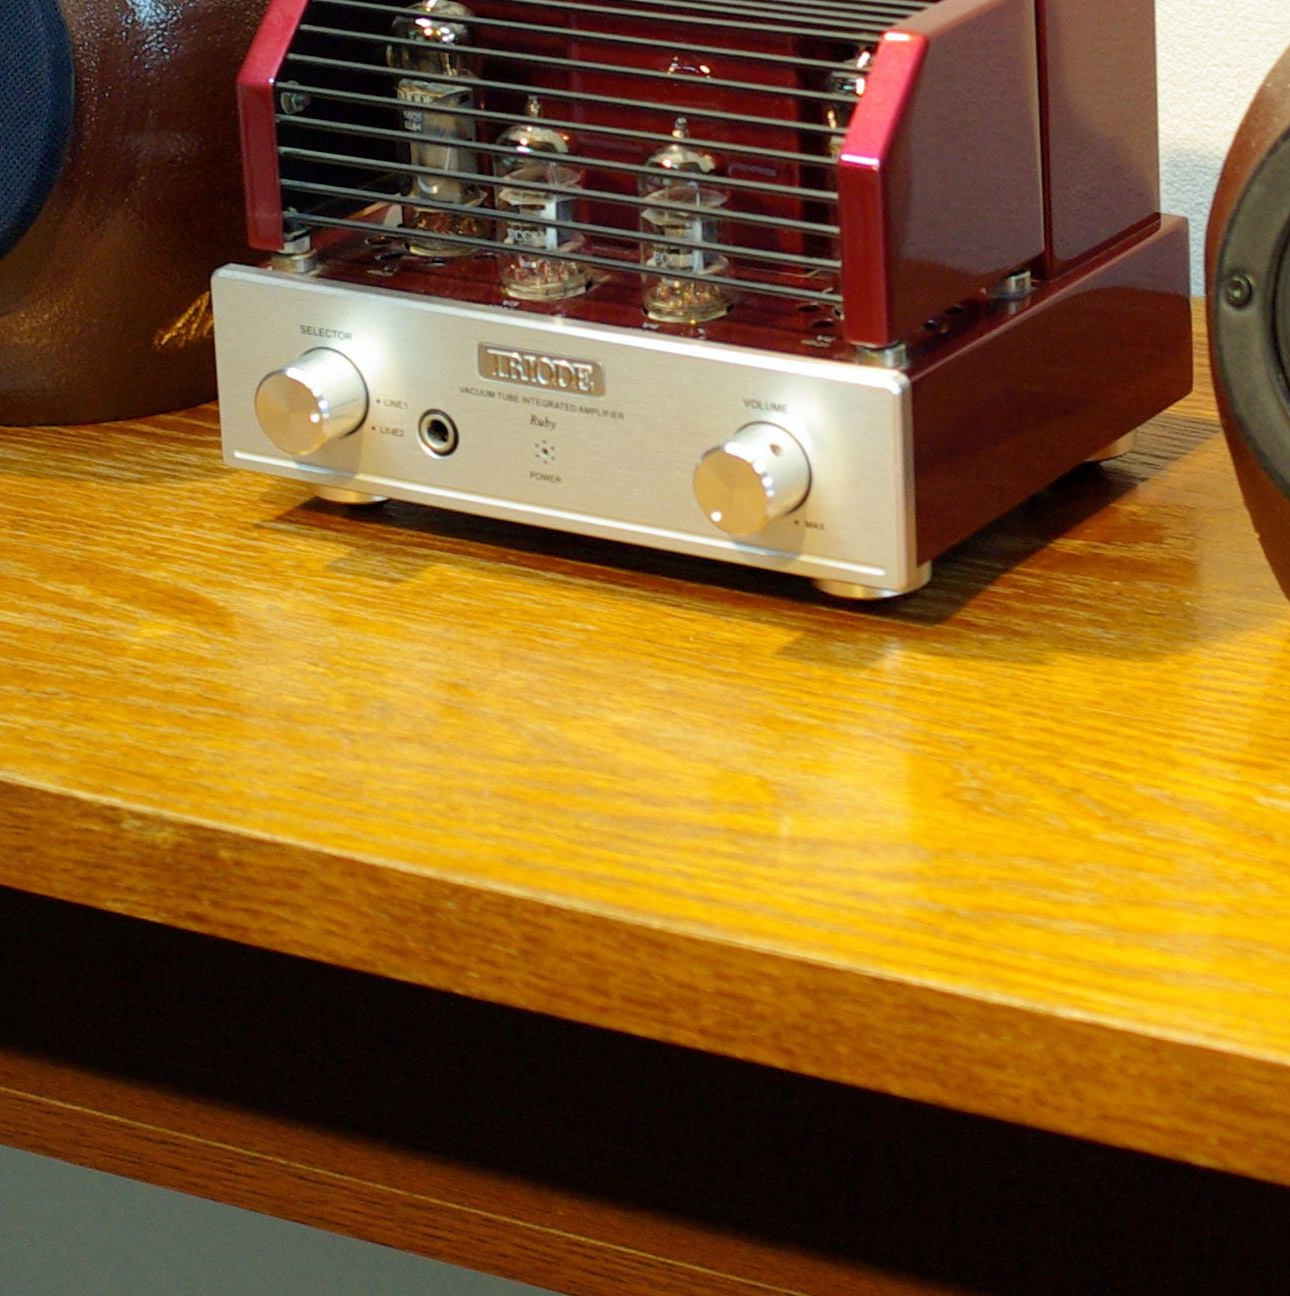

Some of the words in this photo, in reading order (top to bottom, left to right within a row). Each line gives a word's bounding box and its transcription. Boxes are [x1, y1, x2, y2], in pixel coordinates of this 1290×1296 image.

[299, 325, 352, 341] SELECTOR
[485, 348, 596, 392] TRIODE
[383, 399, 409, 410] LINE1
[459, 386, 496, 400] VACUUM
[497, 392, 520, 404] TUBE
[522, 396, 577, 413] INTEGRATED
[578, 405, 625, 421] AMPLIFIER
[742, 398, 788, 413] VOLUME
[529, 414, 558, 431] Ruby
[380, 425, 405, 437] LINE2
[529, 471, 561, 484] POWER
